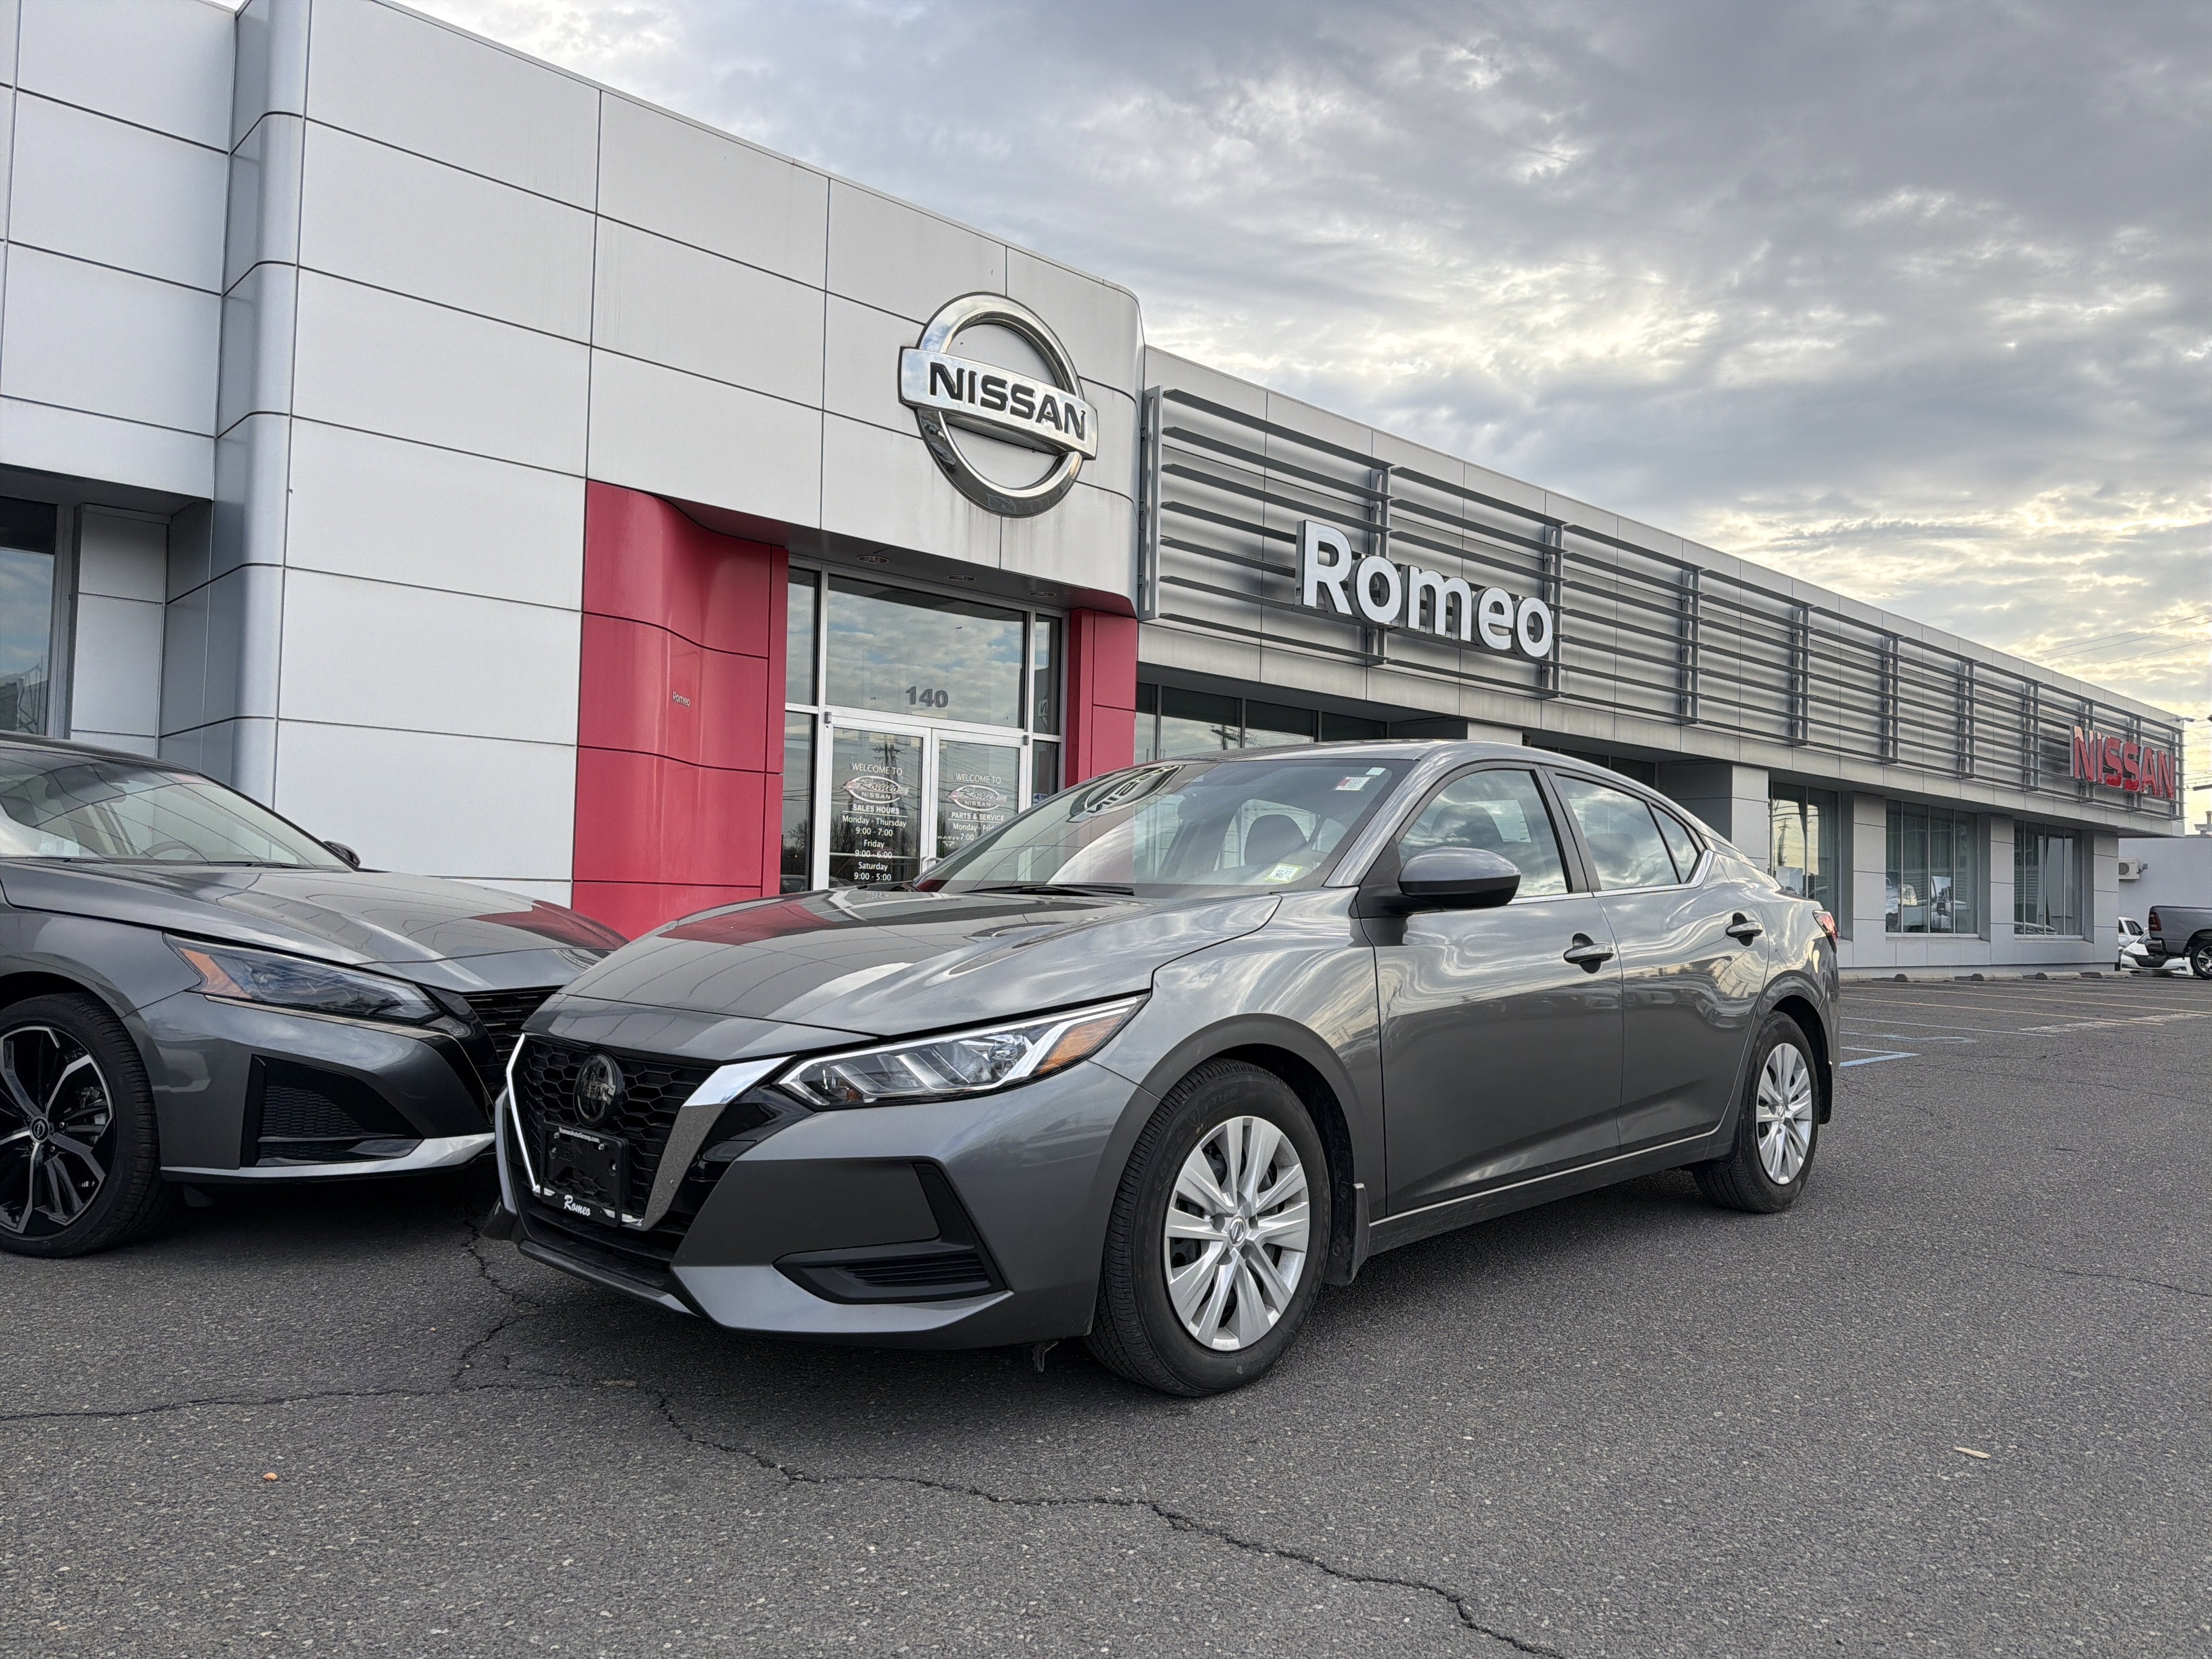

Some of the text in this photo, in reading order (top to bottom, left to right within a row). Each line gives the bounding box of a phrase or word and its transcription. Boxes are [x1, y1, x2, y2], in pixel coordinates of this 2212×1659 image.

[929, 362, 1086, 442] NISSAN
[1296, 519, 1553, 657] Romeo
[673, 691, 691, 707] Romeo
[905, 686, 949, 708] 140
[2070, 725, 2175, 799] NISSAN
[851, 763, 903, 776] WELCOME TO
[856, 777, 899, 793] Romeo
[956, 772, 1002, 785] WELCOME TO
[853, 804, 900, 815] SALES HOURS
[842, 815, 870, 826] Monday
[875, 817, 907, 828] Thursday
[951, 811, 971, 820] PARTS
[979, 813, 1005, 822] SERVICE
[855, 827, 871, 835] 9:00
[953, 823, 978, 832] Monday
[864, 839, 885, 849] Friday
[855, 849, 871, 857] 9:00
[877, 851, 893, 859] 6:00
[858, 861, 888, 872] Saturday
[854, 872, 870, 881] 9:00
[563, 1194, 591, 1217] Romeo
